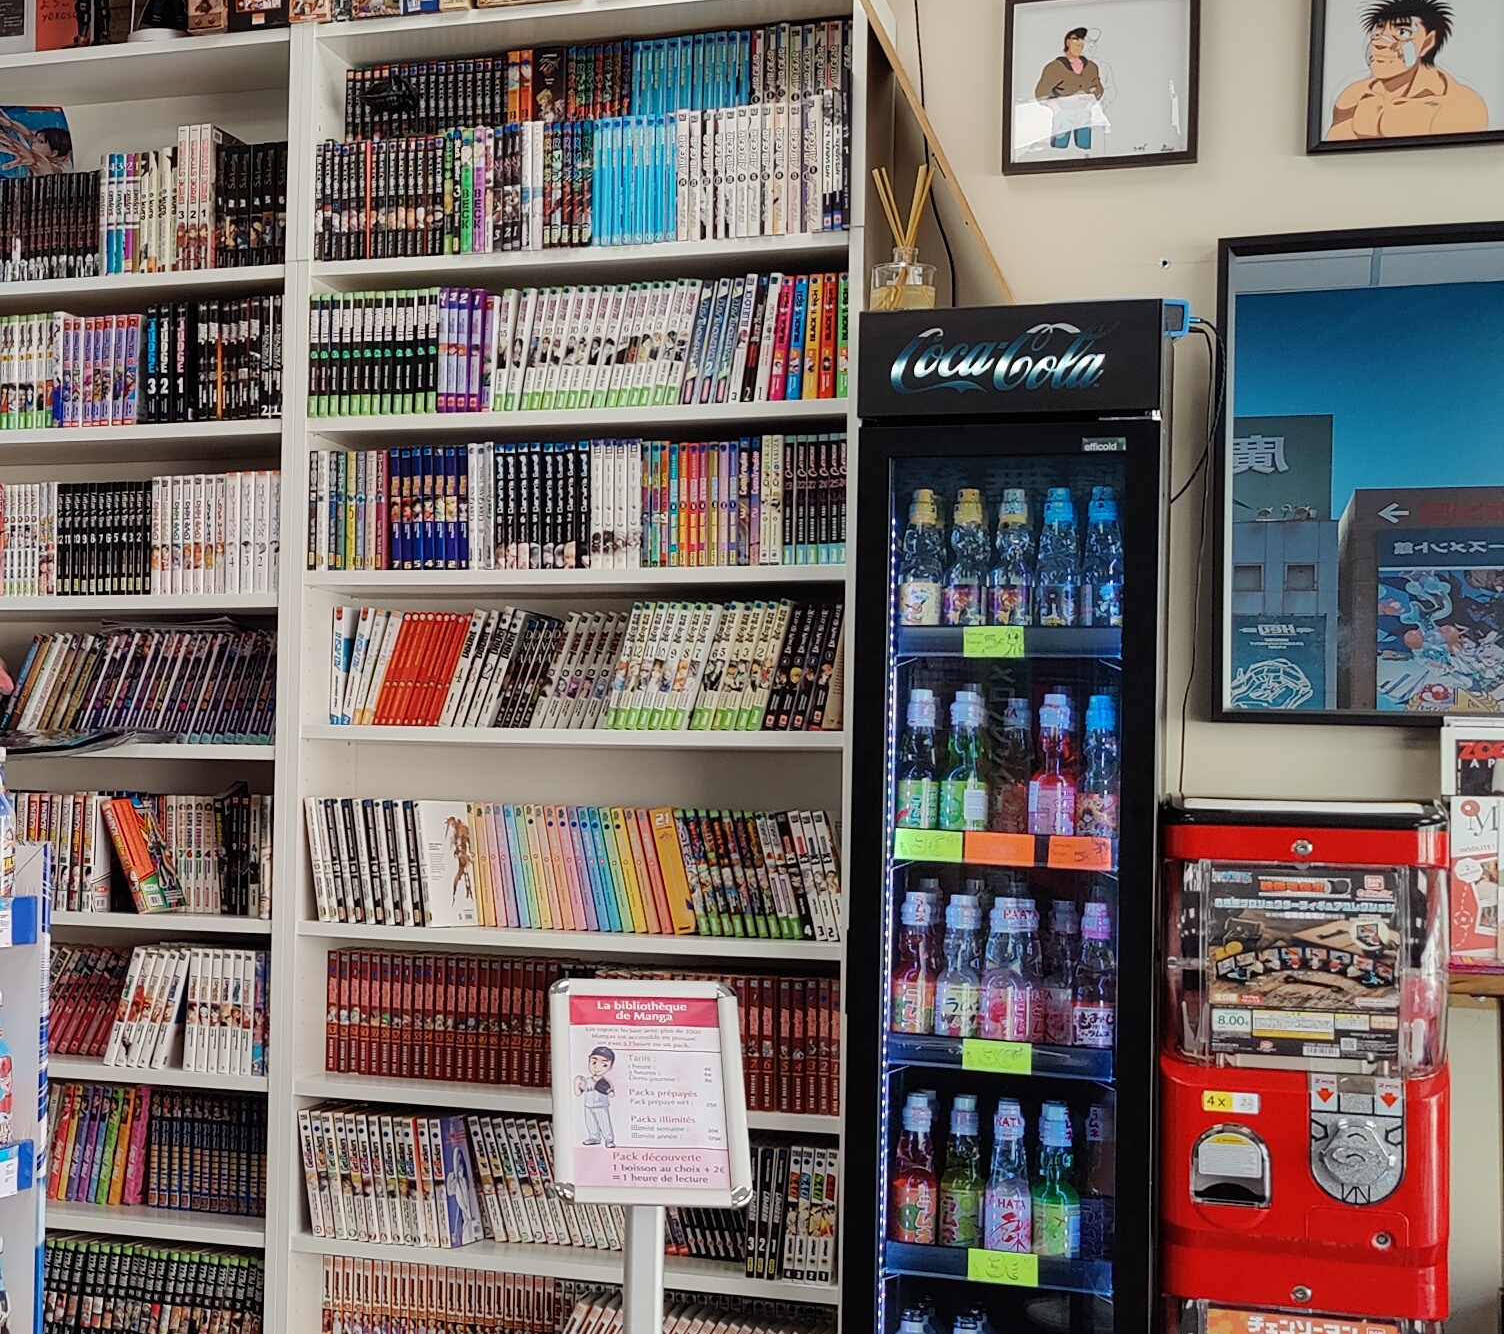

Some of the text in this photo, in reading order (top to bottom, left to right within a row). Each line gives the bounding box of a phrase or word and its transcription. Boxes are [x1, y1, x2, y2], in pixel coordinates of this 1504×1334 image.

[190, 210, 197, 219] 2
[201, 209, 206, 218] 1
[462, 188, 470, 229] BECK
[474, 188, 482, 229] BECK
[178, 211, 185, 220] 3
[148, 318, 156, 373] JUDGE
[160, 318, 169, 373] JUDGE
[177, 318, 185, 373] JUDGE
[890, 322, 1106, 394] Coca-Cola
[148, 377, 156, 394] 3
[160, 377, 169, 394] 2
[177, 377, 185, 394] 1
[597, 1000, 688, 1013] La bibliothèque
[615, 1011, 674, 1023] de Manga
[629, 1088, 698, 1099] Packs prépayés
[1206, 1096, 1215, 1108] 4
[630, 1115, 696, 1124] Packs illimités
[612, 1151, 702, 1163] Pack découverte
[621, 1164, 657, 1174] boisson
[660, 1165, 672, 1173] au
[674, 1164, 701, 1174] choix
[631, 1174, 709, 1184] heure de lecture
[997, 1198, 1027, 1210] HATA
